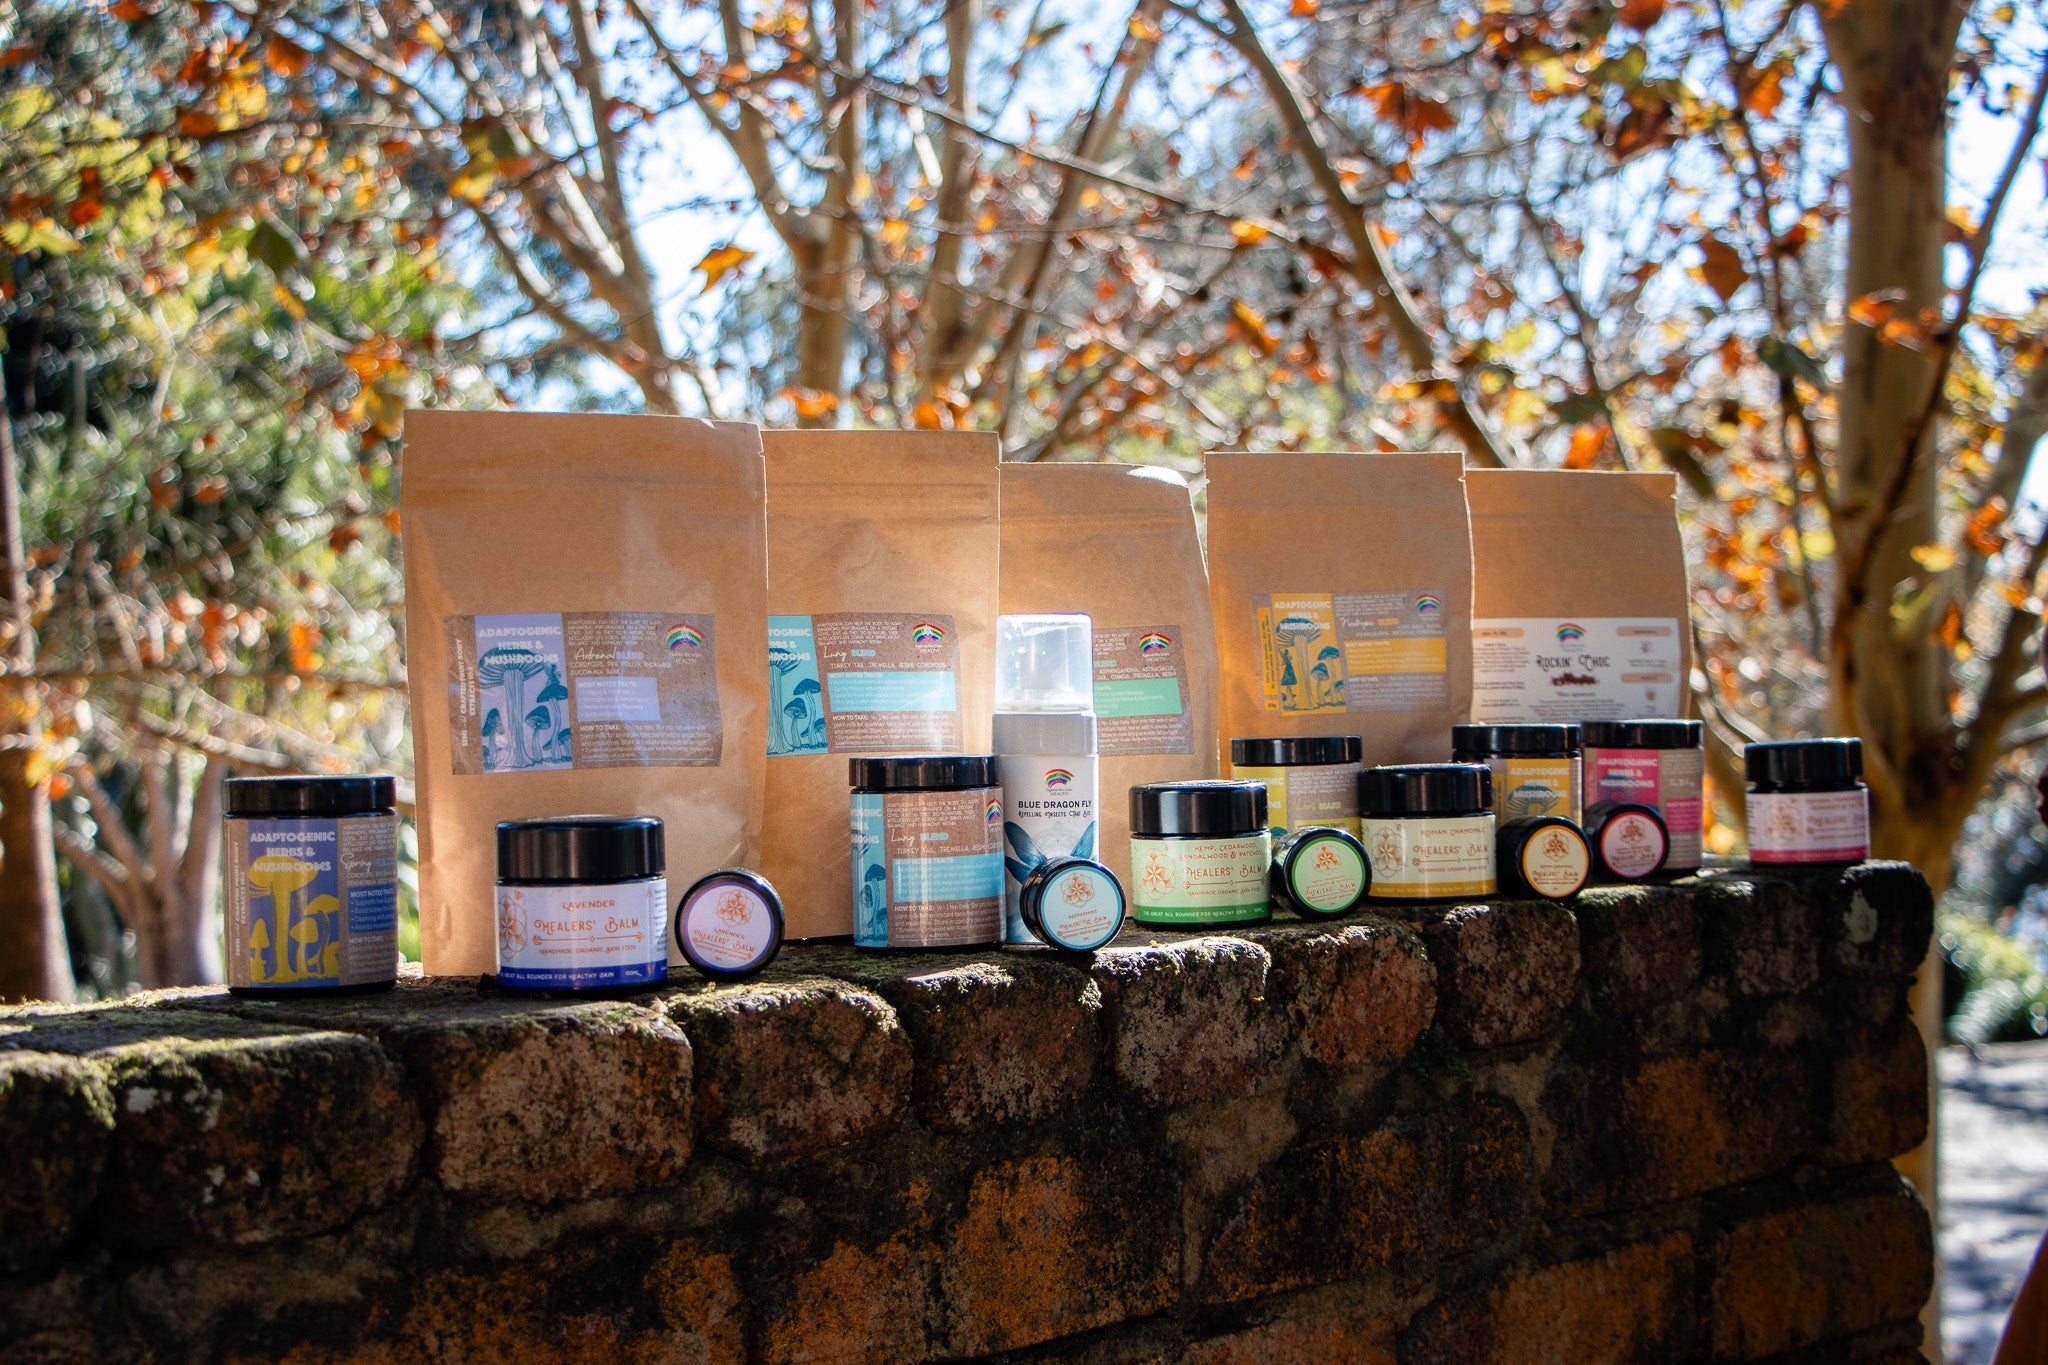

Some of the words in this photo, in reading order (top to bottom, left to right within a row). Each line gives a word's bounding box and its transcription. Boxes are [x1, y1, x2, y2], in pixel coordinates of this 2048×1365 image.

[478, 626, 562, 638] ADAPTOGENIC
[768, 628, 812, 637] TOGENIC
[456, 639, 464, 660] BODY
[498, 641, 532, 650] HERBS
[536, 640, 544, 650] &
[484, 653, 559, 664] MUSHROOMS
[574, 646, 616, 660] Adrenal
[824, 646, 847, 662] Lung
[1578, 654, 1610, 672] CHOC
[458, 661, 466, 681] FRUIT
[459, 682, 467, 714] CRAFTED
[1018, 800, 1040, 808] BLUE
[1044, 800, 1080, 808] DRAGON
[1082, 800, 1092, 808] FLY
[1018, 810, 1042, 818] REPELLING
[250, 832, 336, 842] ADAPTOGENIC
[891, 828, 915, 847] Lung
[266, 848, 304, 857] HERBS
[306, 846, 316, 857] &
[1194, 845, 1216, 853] HEMP,
[1220, 842, 1258, 852] CEDARWOOD,
[1412, 845, 1462, 858] HEALERS'
[341, 852, 372, 872] Spring
[1178, 853, 1228, 861] SANDALWOOD
[1230, 850, 1237, 860] &
[254, 861, 332, 872] MUSHROOMS
[1182, 866, 1234, 880] HEALERS'
[1240, 864, 1262, 878] BALM
[562, 899, 616, 912] LAVENDER
[534, 919, 596, 936] HEALERS'
[605, 916, 639, 933] BALM
[713, 927, 746, 940] LAVENDER
[694, 929, 730, 944] HEALERS'
[732, 941, 754, 952] BALM
[540, 948, 572, 956] HANDMADE
[569, 973, 598, 981] HEALTHY
